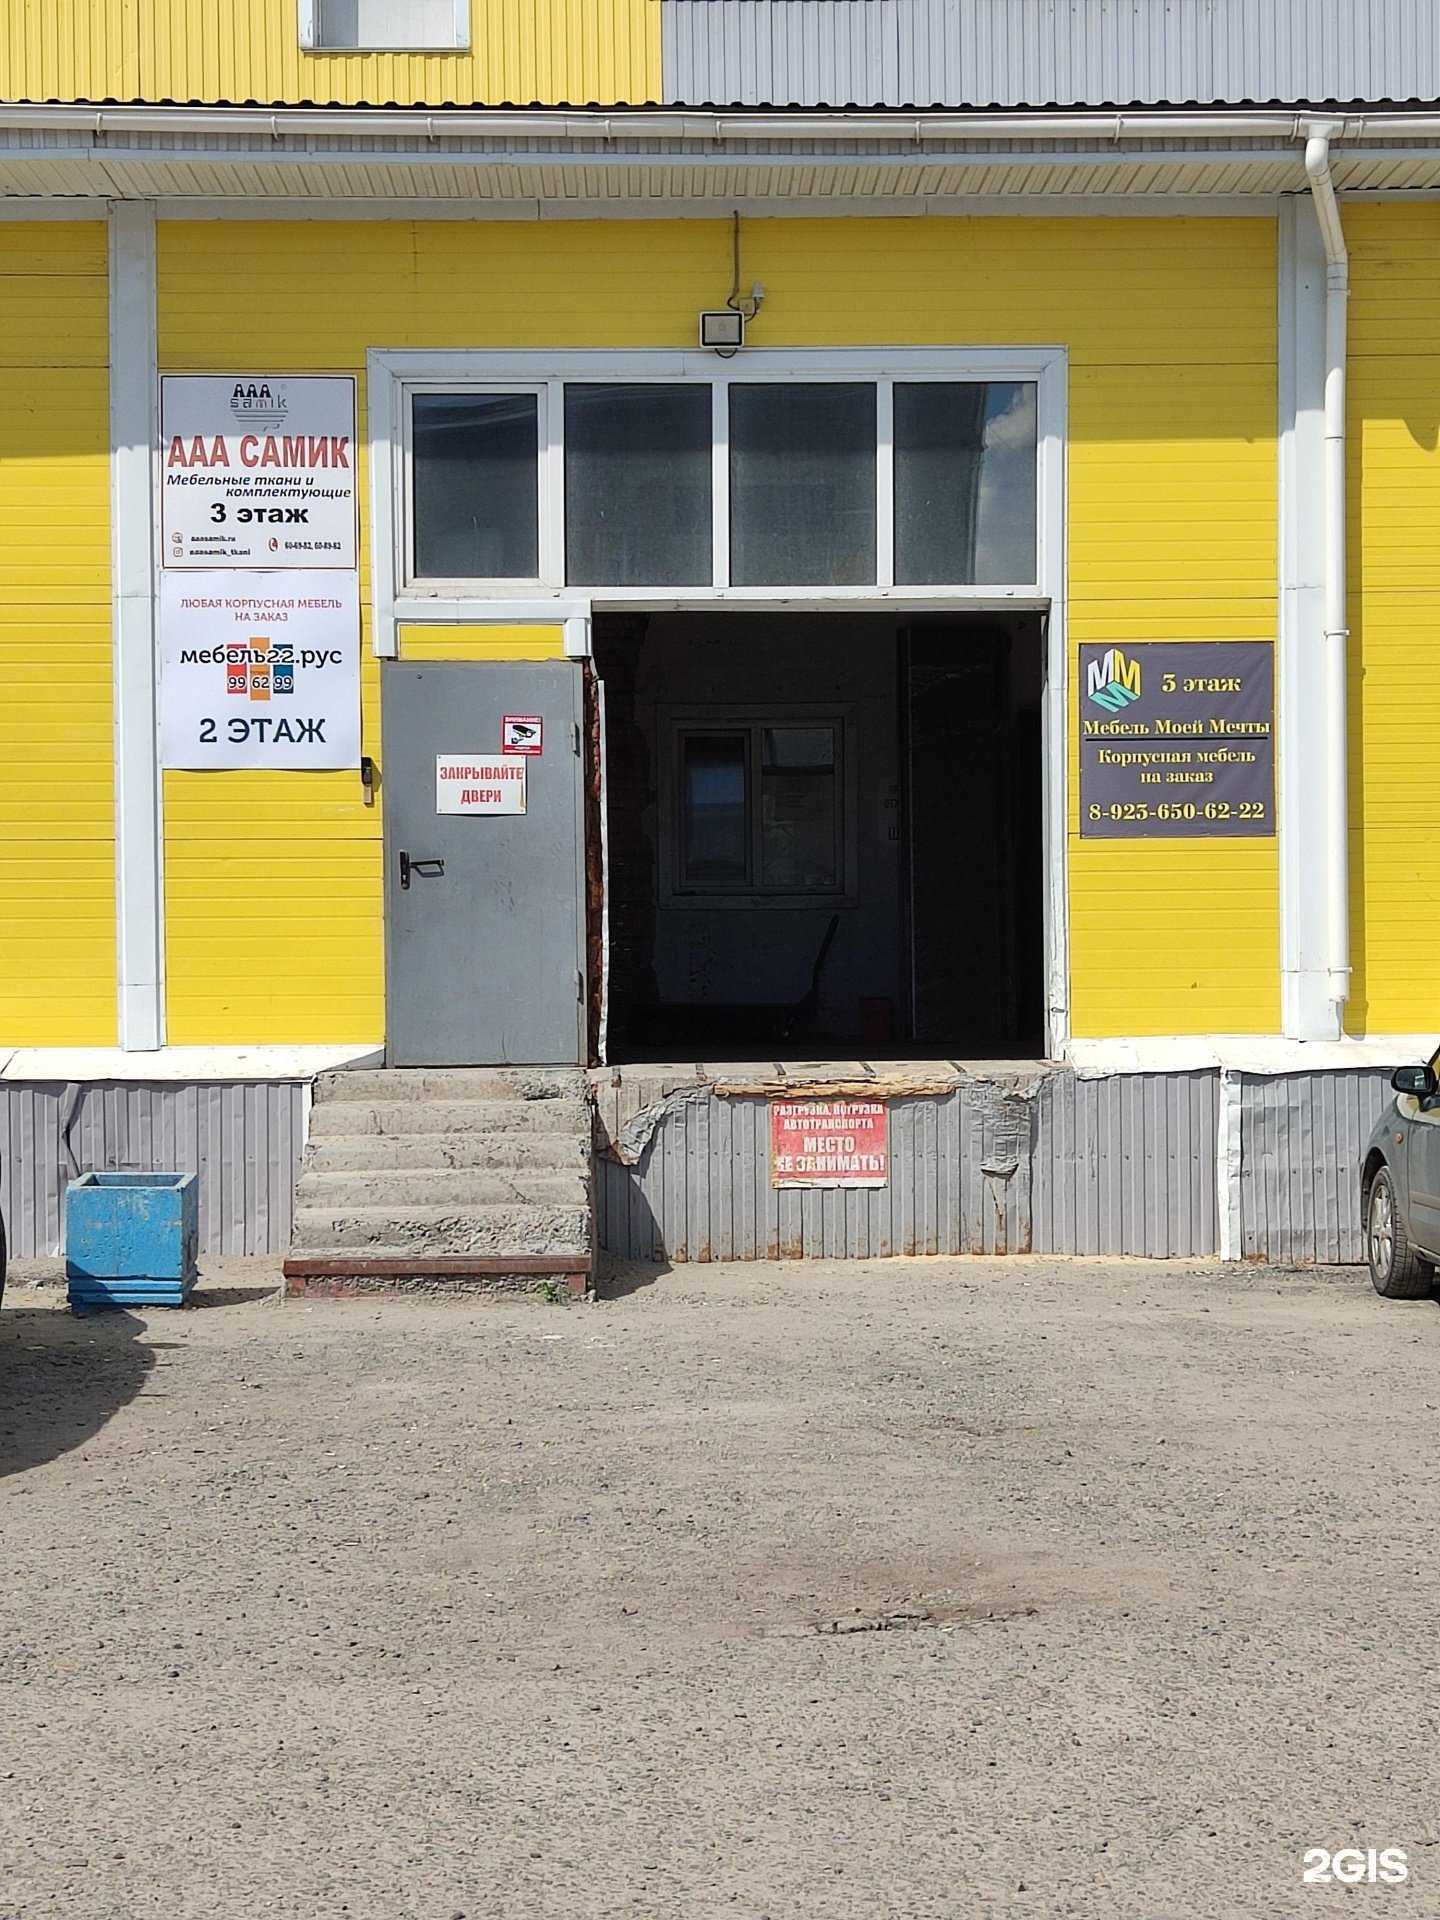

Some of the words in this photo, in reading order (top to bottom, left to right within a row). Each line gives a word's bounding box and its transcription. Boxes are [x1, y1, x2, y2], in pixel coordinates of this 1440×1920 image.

[232, 383, 271, 398] AAA
[230, 395, 287, 409] samik
[167, 435, 230, 468] ААА
[239, 434, 350, 468] САМИК
[166, 474, 250, 486] Мебельные
[254, 476, 301, 486] ткани
[305, 476, 314, 486] и
[225, 487, 351, 499] комплектующие
[210, 502, 226, 523] 3
[236, 507, 309, 523] этаж
[180, 599, 222, 609] ЛЮБАЯ
[226, 599, 295, 609] КОРПУСНАЯ
[297, 599, 342, 609] МЕБЕЛЬ
[235, 612, 251, 621] НА
[254, 612, 289, 622] ЗАКАЗ
[180, 644, 342, 669] мебель22.рус
[228, 676, 246, 689] 99
[252, 676, 270, 689] 62
[274, 676, 292, 689] 99
[1183, 677, 1242, 692] этаж
[199, 718, 217, 743] 2
[227, 718, 326, 743] ЭТАЖ
[1083, 720, 1150, 736] Мебель
[1154, 719, 1204, 735] Моей
[1209, 719, 1270, 734] Мечты
[1098, 749, 1191, 767] Корпусная
[1197, 748, 1256, 763] мебель
[440, 766, 524, 780] ЗАКРЫВАЙТЕ
[1140, 773, 1161, 783] на
[1165, 772, 1213, 783] заказ
[460, 790, 502, 804] ДВЕРИ
[1088, 802, 1265, 821] 8-923-650-62-22
[833, 1103, 884, 1116] ПОГРУЗКА
[783, 1117, 874, 1130] АВТОТРАНСПОРТА
[803, 1136, 855, 1153] МЕСТО
